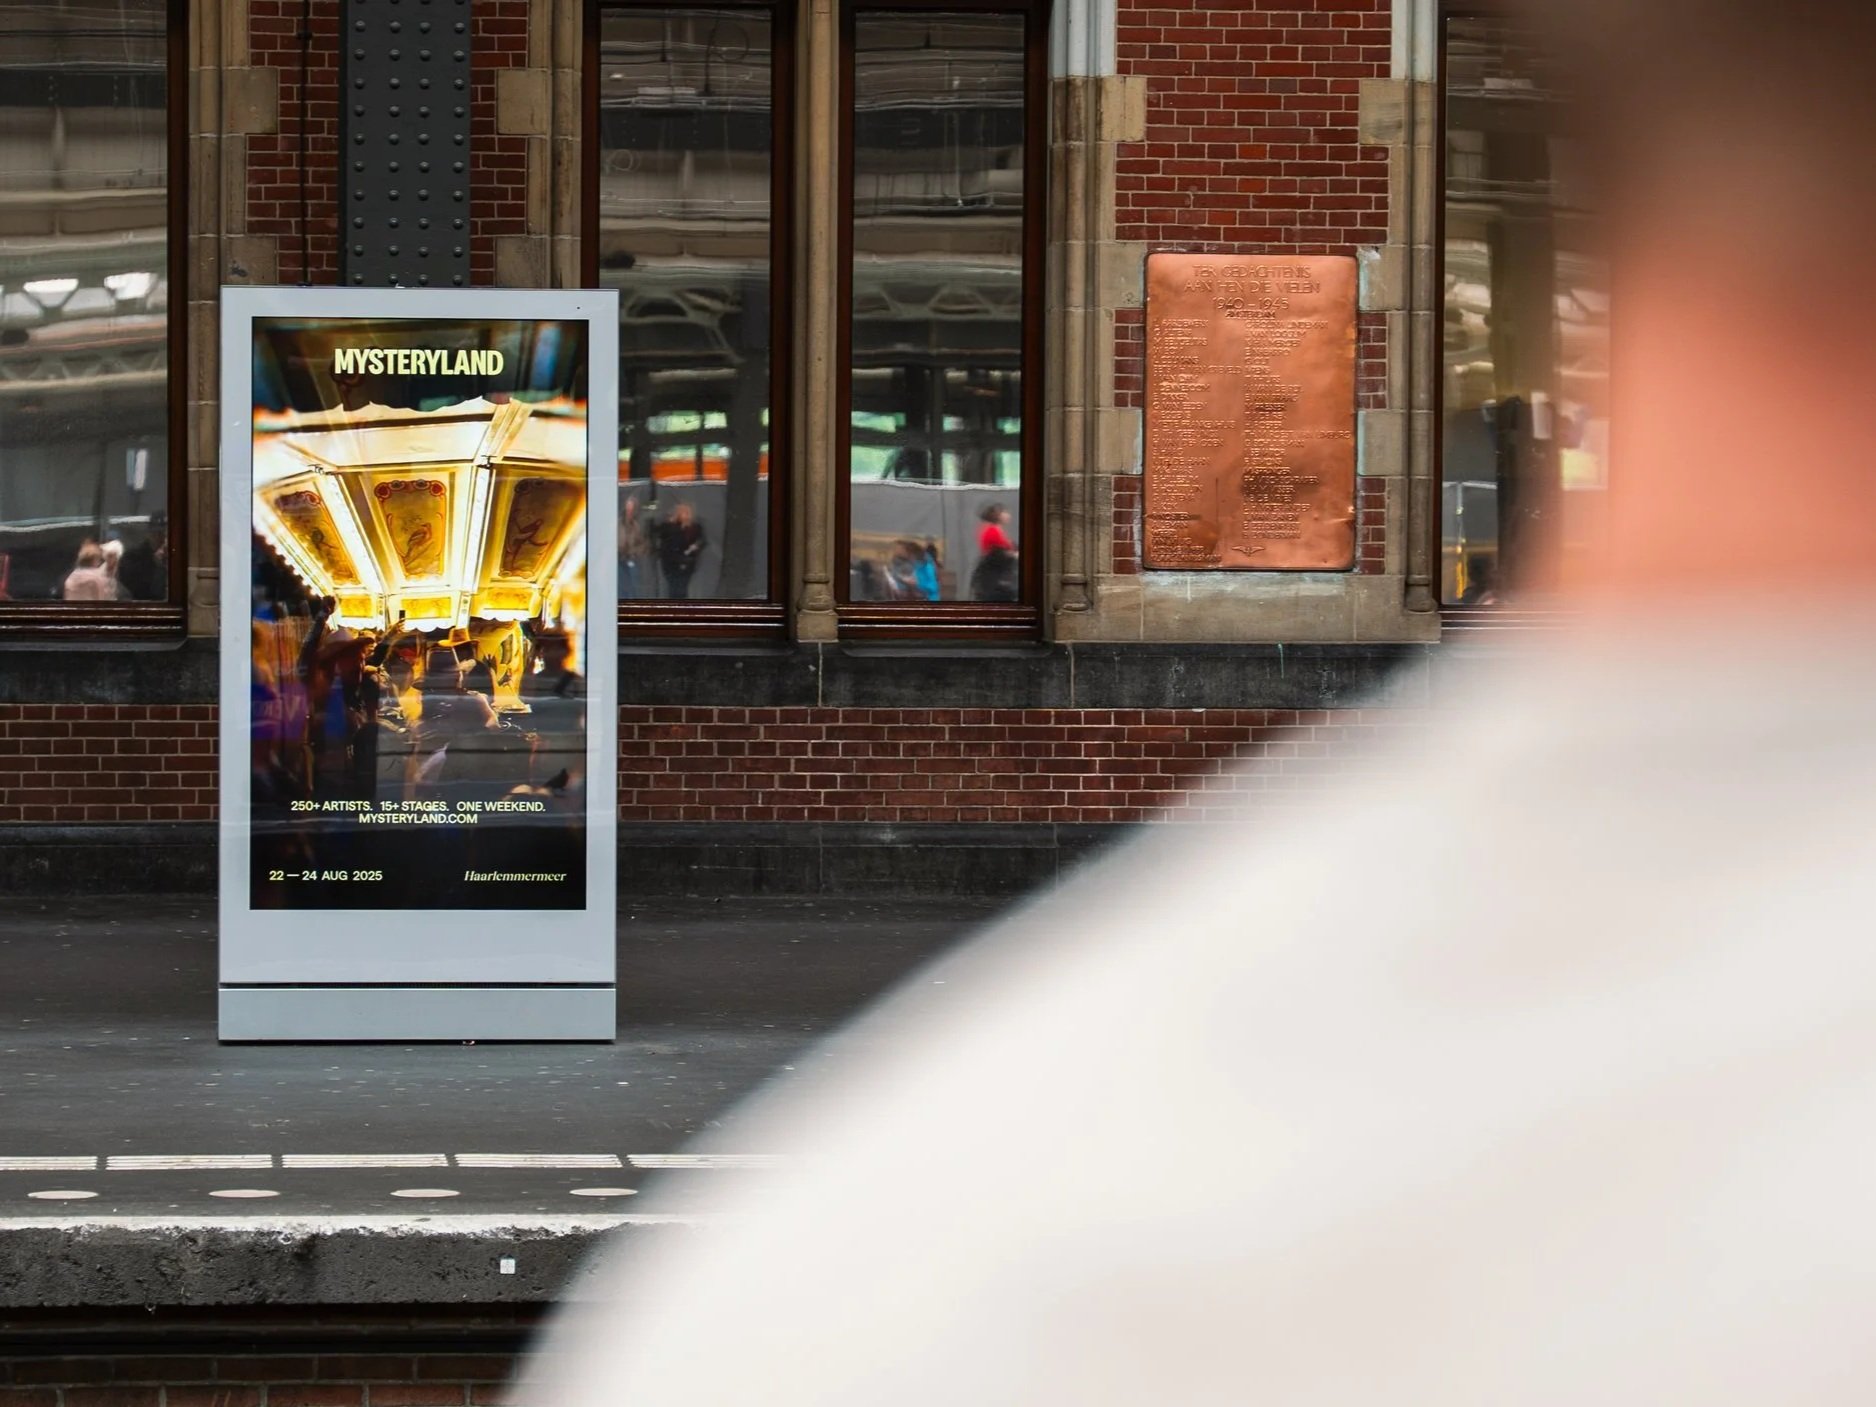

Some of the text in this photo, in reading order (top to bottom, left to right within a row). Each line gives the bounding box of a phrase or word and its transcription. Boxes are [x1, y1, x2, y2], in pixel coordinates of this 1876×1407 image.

[1192, 265, 1311, 279] TER GEDACHTENIS
[1184, 280, 1320, 294] AAN HEN DIE VIELEN
[1213, 297, 1244, 309] 1940
[1259, 297, 1289, 310] 1945
[1225, 310, 1276, 318] AMSTERDAM
[335, 348, 504, 375] MYSTERYLAND
[291, 801, 546, 811] 250+ ARTISTS. 15+ STAGES. ONE WEEKEND.
[359, 813, 478, 824] MYSTERYLAND.COM
[269, 871, 284, 881] 22
[302, 871, 317, 881] 24
[321, 871, 348, 881] AUG
[353, 871, 383, 881] 2025
[464, 871, 567, 882] Haarlemmermeer
